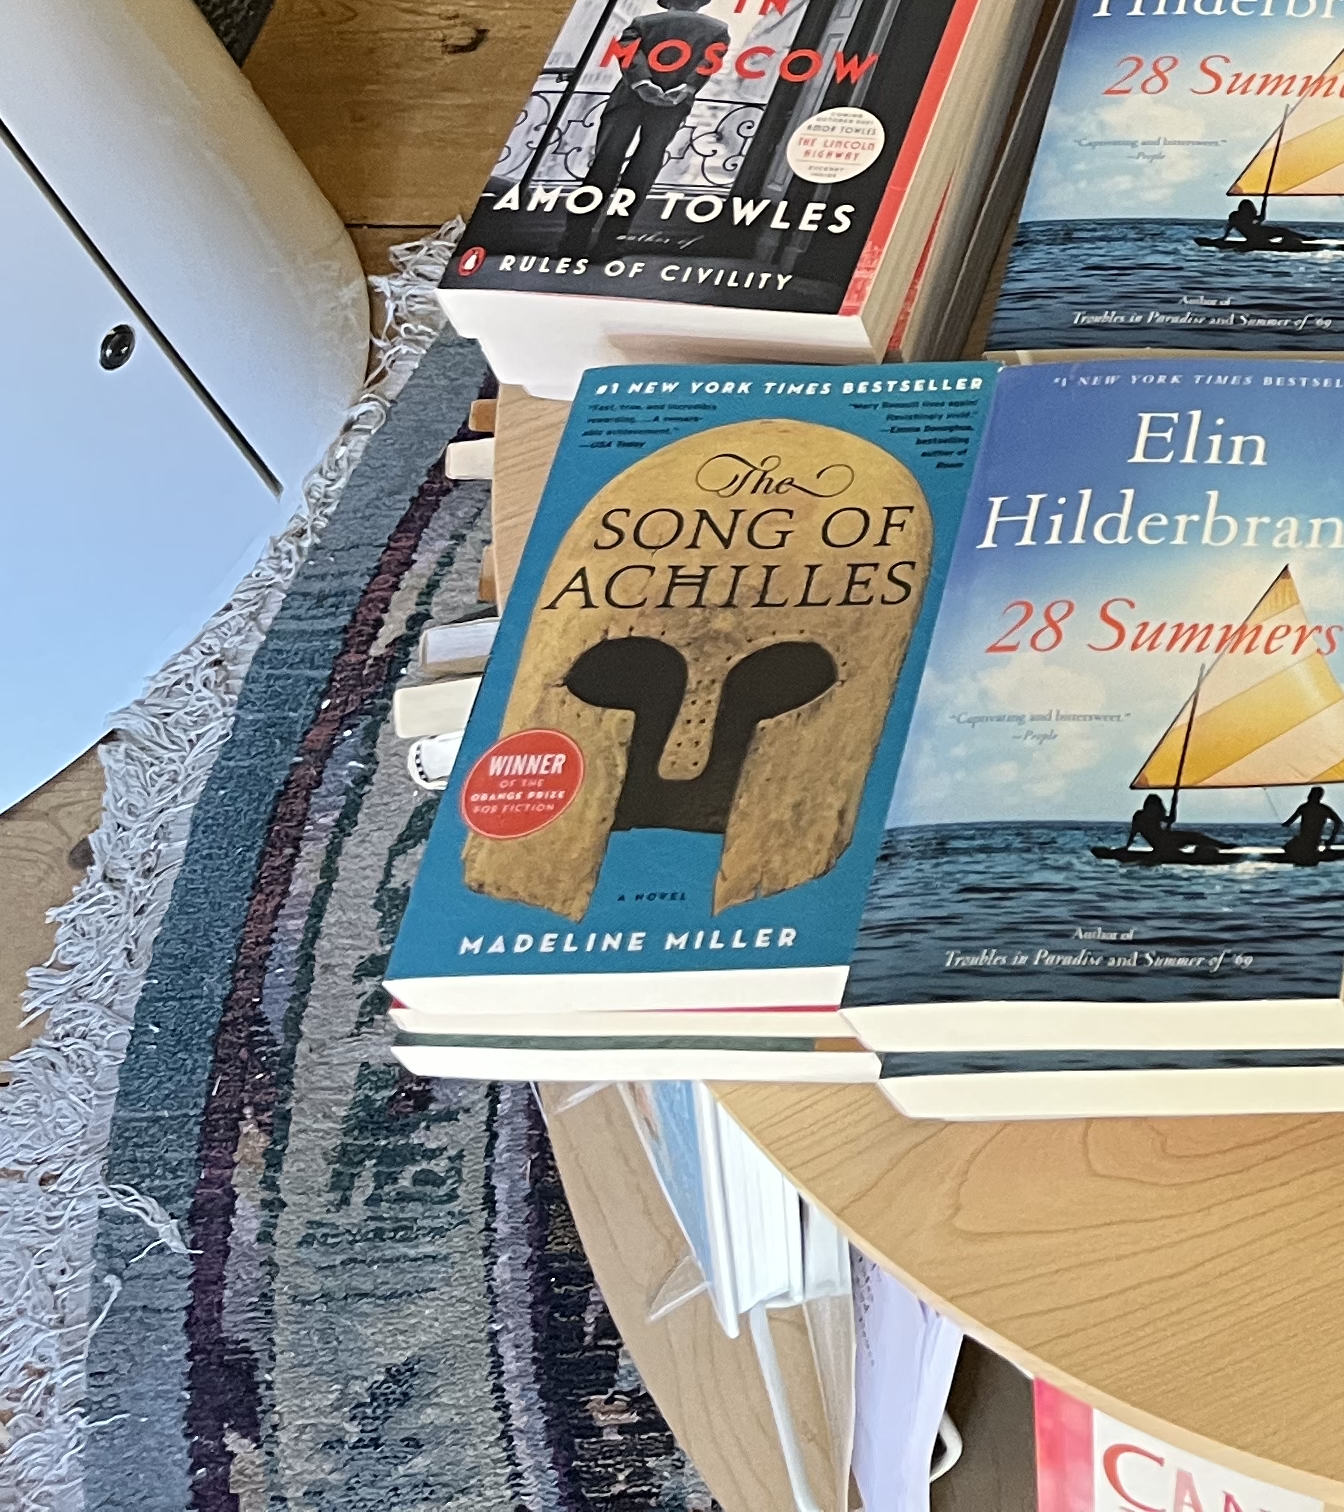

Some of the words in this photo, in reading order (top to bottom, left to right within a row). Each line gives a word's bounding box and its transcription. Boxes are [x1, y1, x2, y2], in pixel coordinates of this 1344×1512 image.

[599, 38, 878, 84] MOSCOW
[1102, 55, 1179, 97] 28
[493, 185, 636, 218] AMOR
[659, 191, 856, 235] TOWLES
[499, 255, 590, 276] RULES
[604, 260, 645, 278] OF
[660, 264, 793, 292] CIVILITY
[1127, 410, 1268, 467] Elin
[695, 453, 854, 499] The
[593, 507, 795, 550] SONG
[820, 505, 914, 548] OF
[542, 562, 916, 611] ACHILLES
[985, 599, 1075, 654] 28
[1088, 597, 1344, 657] Summers
[488, 753, 566, 777] WINNER
[459, 931, 645, 956] MADELINE
[664, 928, 798, 951] MILLER
